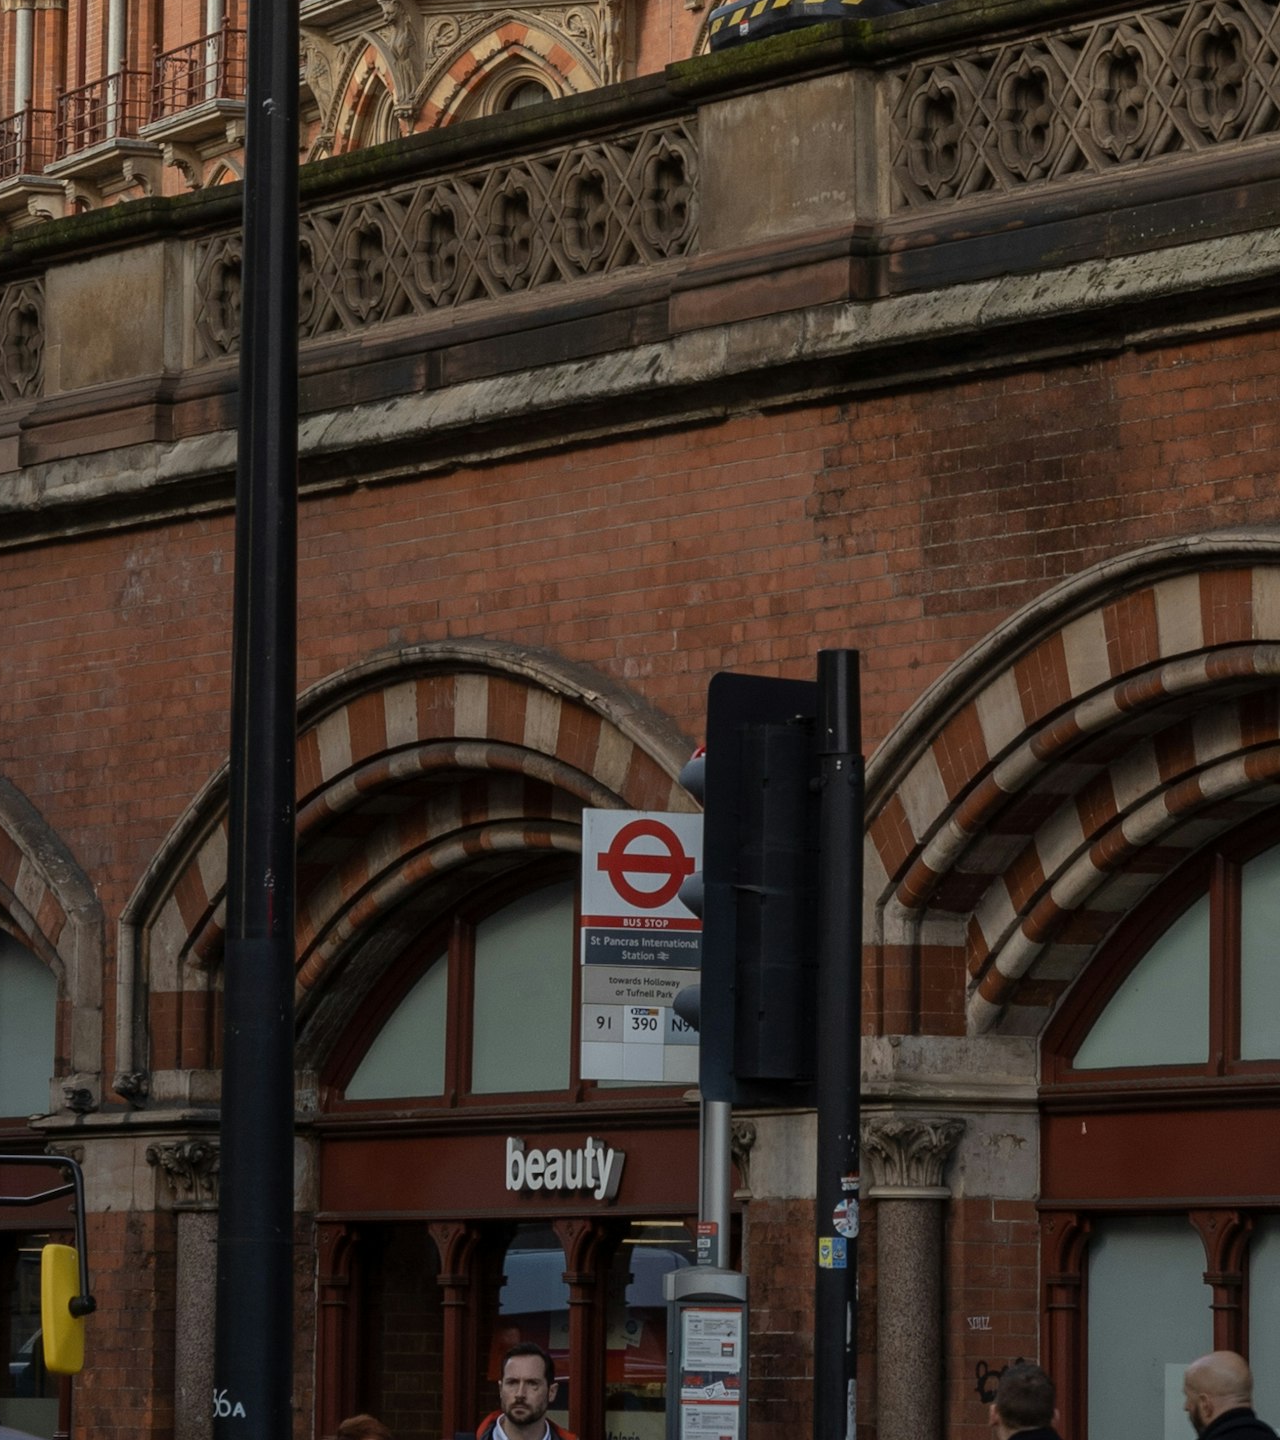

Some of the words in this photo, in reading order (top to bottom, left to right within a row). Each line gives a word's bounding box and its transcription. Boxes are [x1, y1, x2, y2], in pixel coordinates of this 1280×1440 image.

[622, 917, 642, 928] BUS
[644, 918, 669, 929] STOP
[590, 935, 601, 946] St
[603, 936, 639, 948] Pancras
[641, 937, 699, 950] International
[621, 950, 655, 961] Station
[608, 976, 641, 987] towards
[643, 977, 681, 989] Holloway
[615, 989, 624, 997] or
[626, 987, 655, 998] Tufnell
[655, 988, 673, 1000] Park
[596, 1016, 613, 1030] 91
[631, 1016, 658, 1032] 390
[670, 1017, 700, 1033] N9
[505, 1135, 616, 1201] beauty
